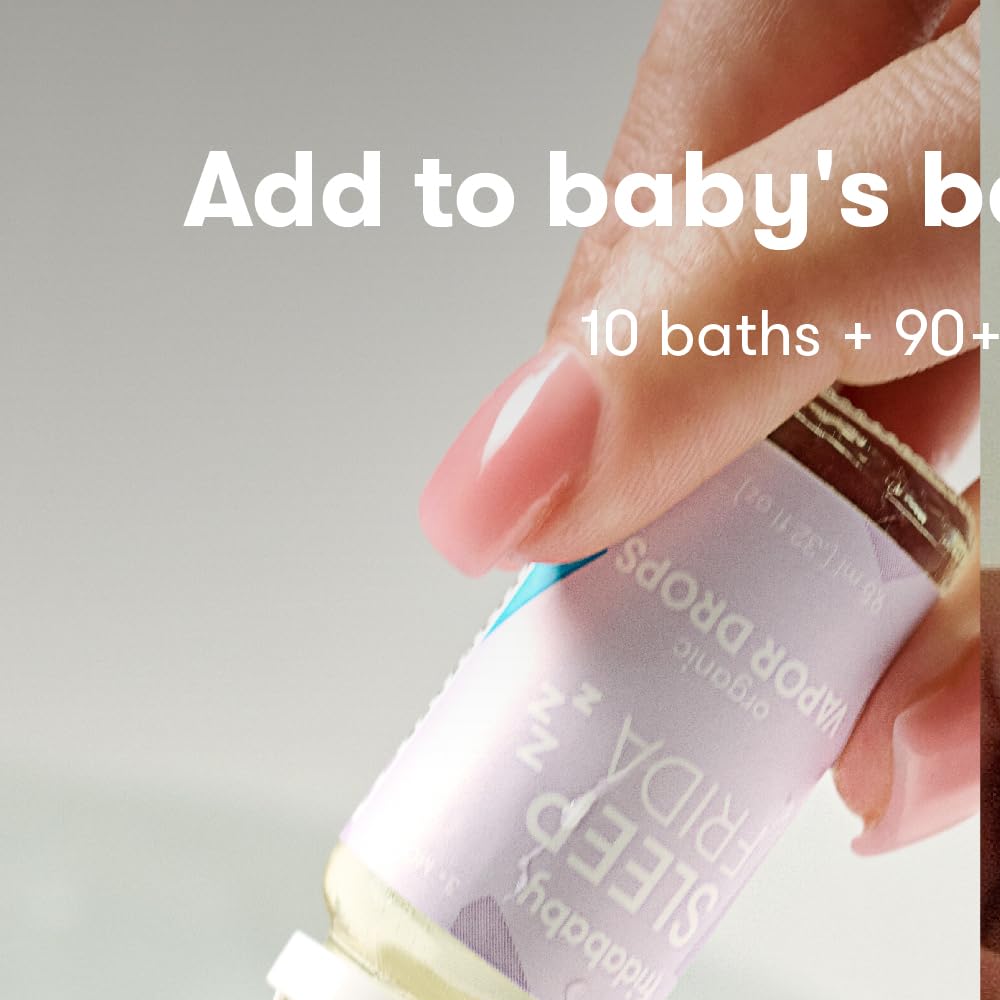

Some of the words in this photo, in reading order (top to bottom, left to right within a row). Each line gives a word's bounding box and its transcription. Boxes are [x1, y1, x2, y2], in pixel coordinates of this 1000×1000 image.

[615, 535, 754, 655] DROPS
[672, 638, 769, 722] organic
[751, 637, 849, 738] VAPOR
[607, 714, 768, 879] FRIDA
[526, 791, 719, 948] SLEEP
